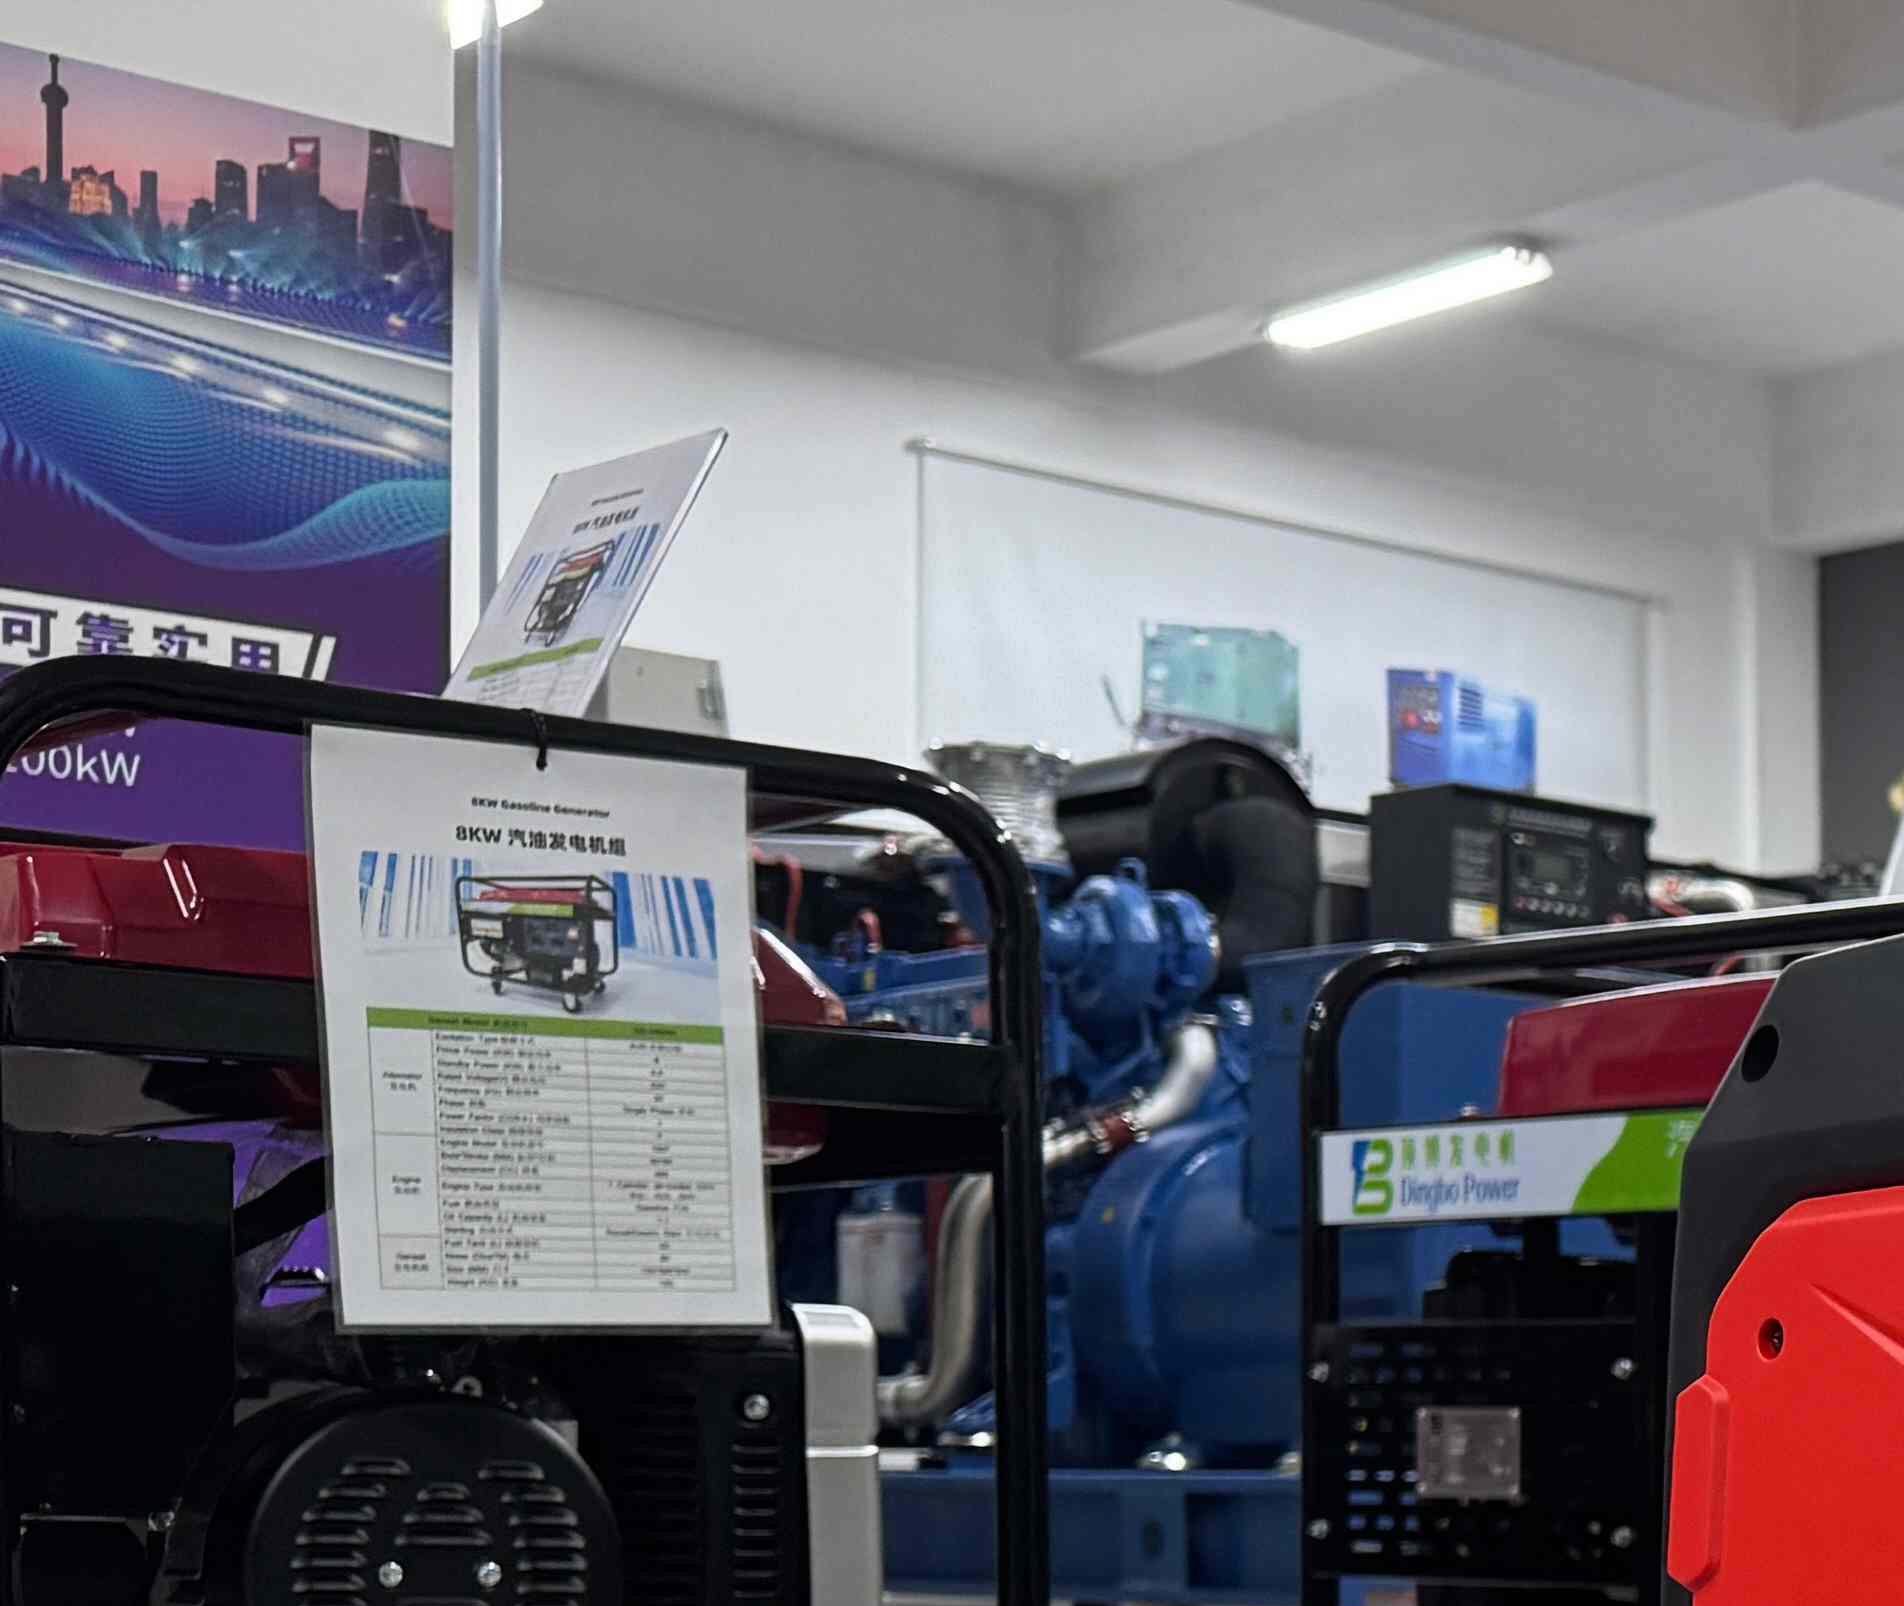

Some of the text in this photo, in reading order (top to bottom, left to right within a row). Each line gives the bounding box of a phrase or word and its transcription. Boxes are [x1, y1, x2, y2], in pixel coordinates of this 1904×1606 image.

[5, 743, 140, 787] 00kW
[456, 825, 627, 857] 8KW 汽油发电机组
